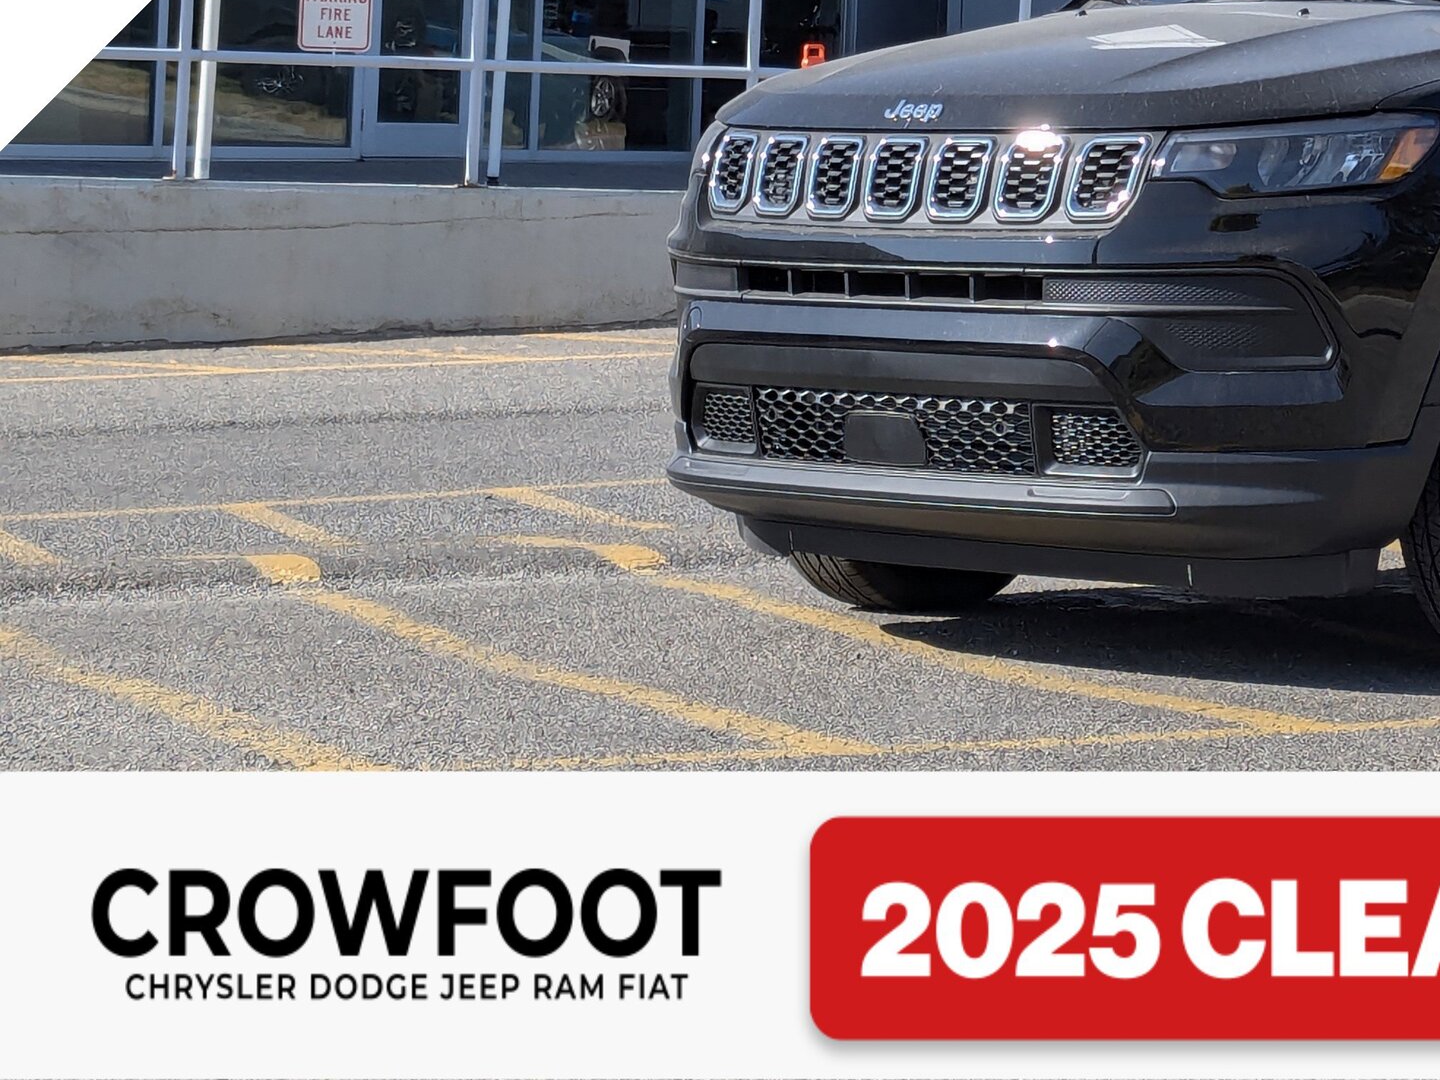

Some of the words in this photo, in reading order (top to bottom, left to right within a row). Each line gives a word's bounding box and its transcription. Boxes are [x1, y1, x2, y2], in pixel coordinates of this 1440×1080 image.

[320, 7, 352, 22] FIRE
[317, 25, 353, 39] LANE
[884, 99, 944, 123] Jeep
